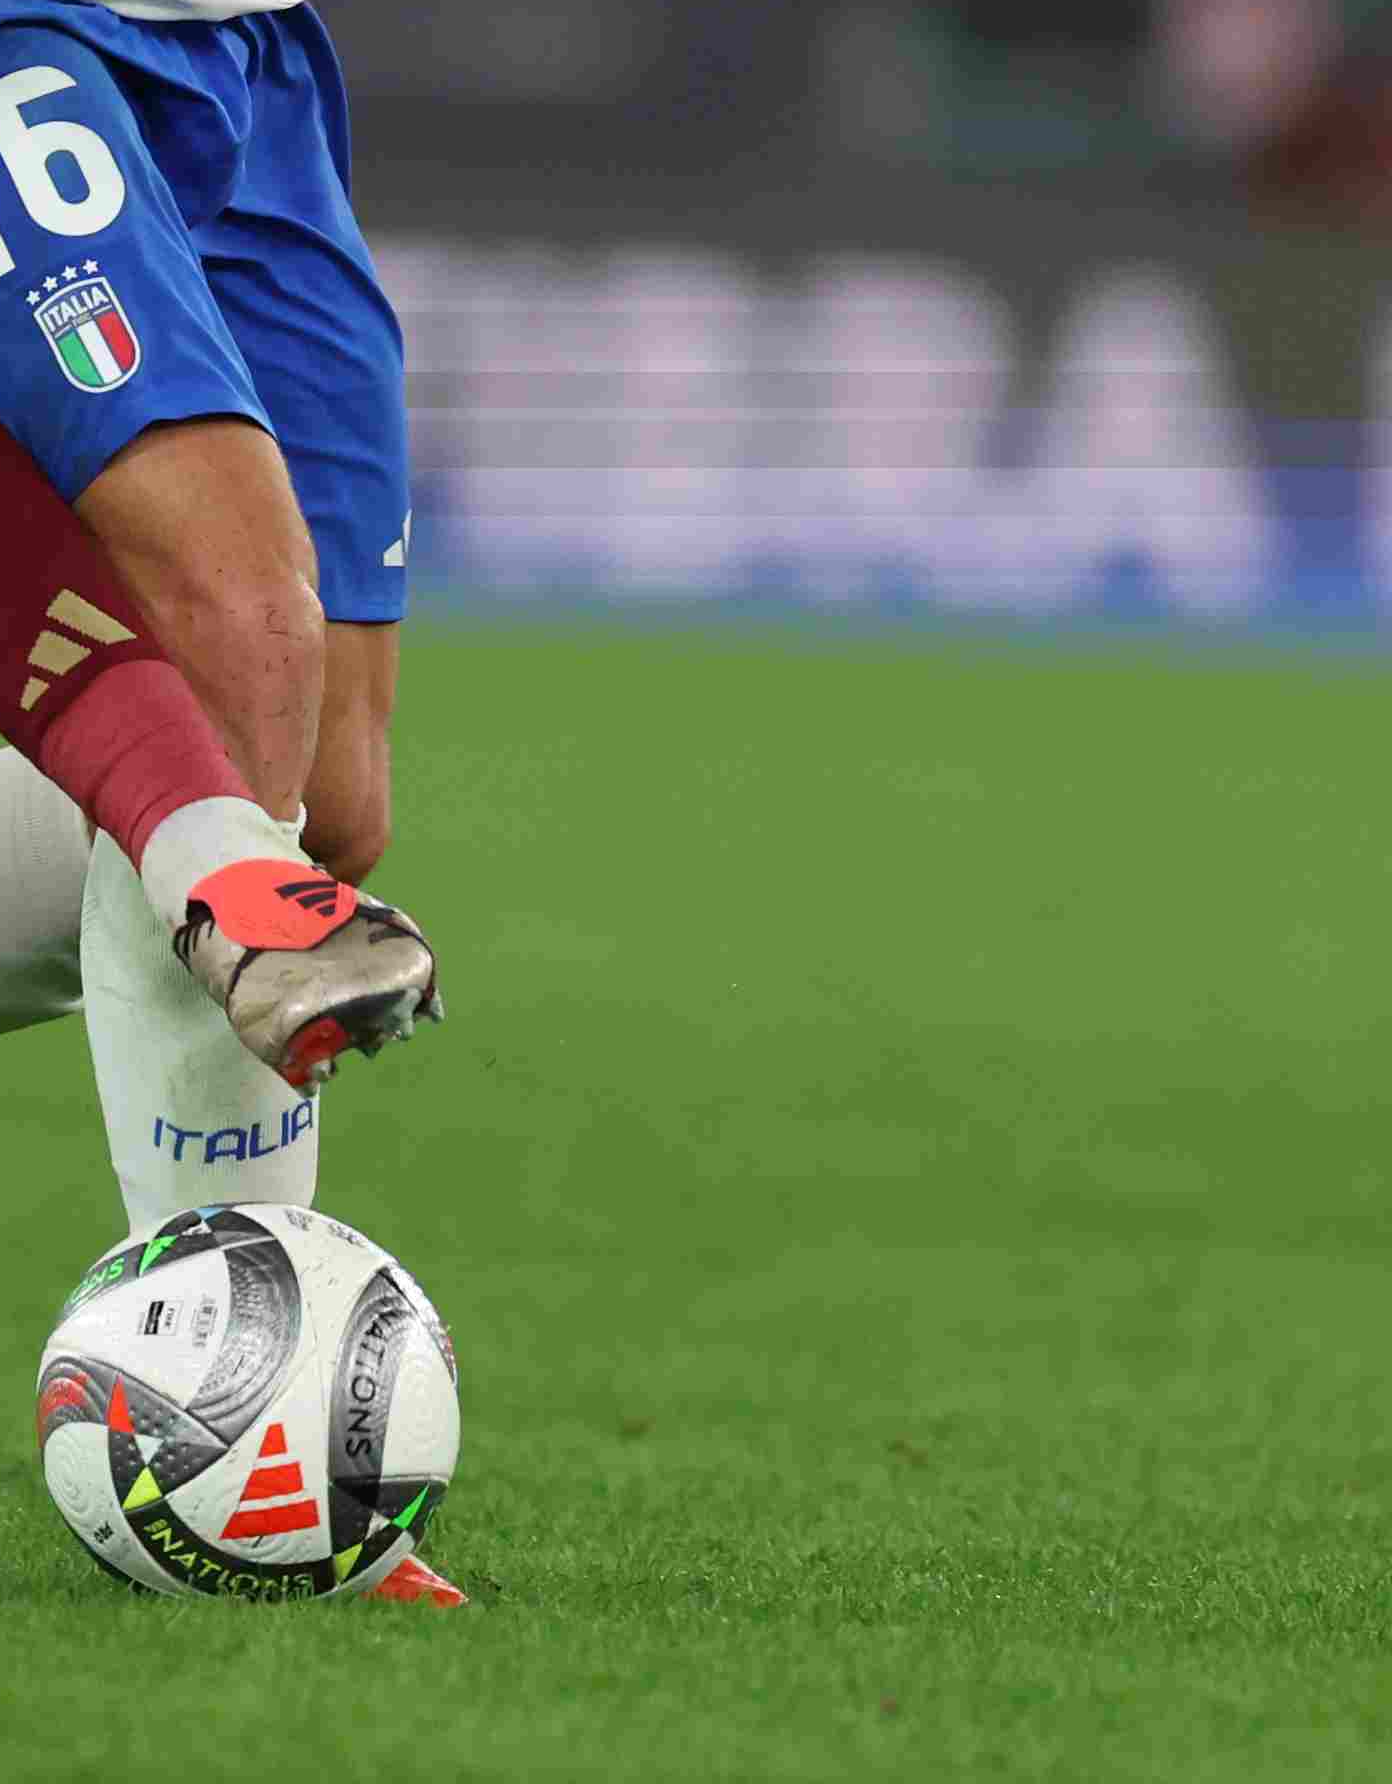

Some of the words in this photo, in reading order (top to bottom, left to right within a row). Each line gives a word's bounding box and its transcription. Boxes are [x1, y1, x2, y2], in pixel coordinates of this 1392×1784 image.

[42, 286, 110, 333] ITALIA
[154, 1099, 313, 1163] ITALIA
[345, 1297, 409, 1460] NATIONS
